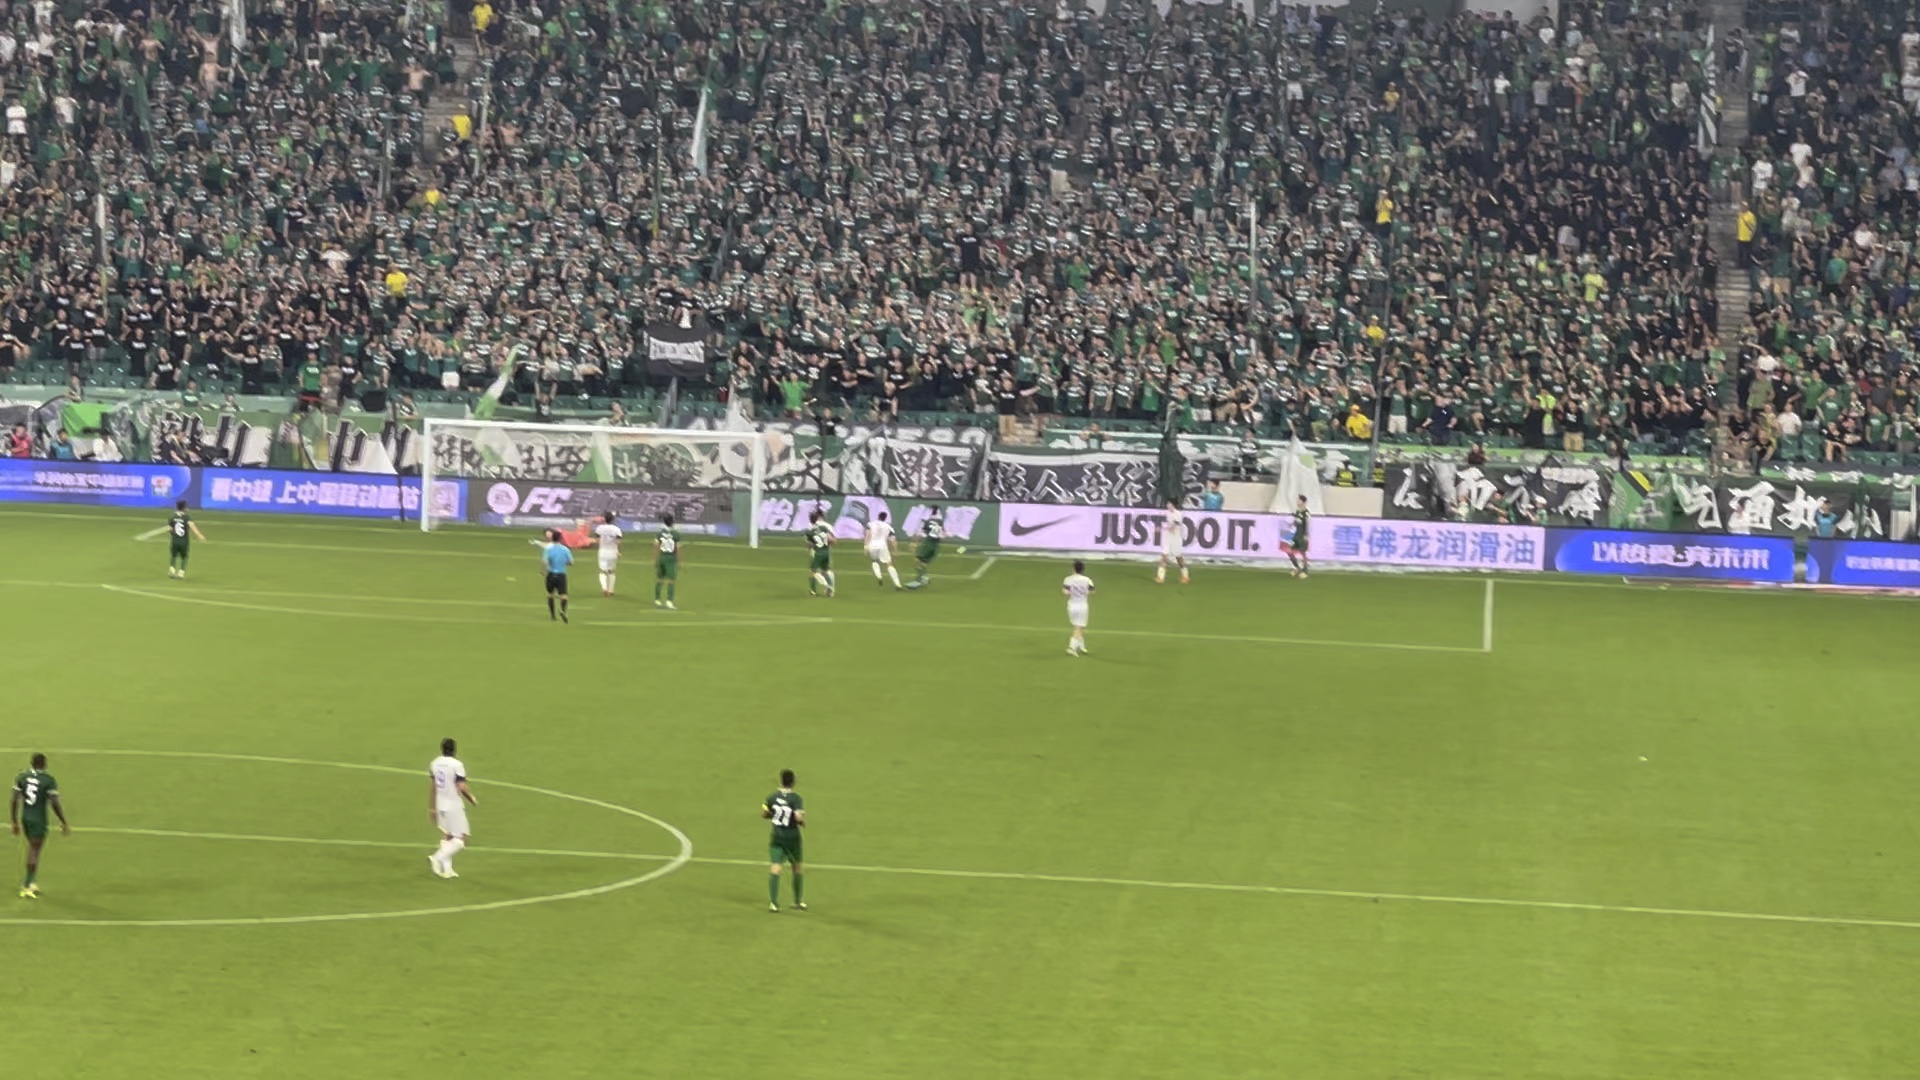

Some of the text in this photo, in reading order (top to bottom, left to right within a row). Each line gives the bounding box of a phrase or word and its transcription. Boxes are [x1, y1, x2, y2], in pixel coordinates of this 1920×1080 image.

[520, 487, 573, 513] FC
[1095, 512, 1168, 547] JUST
[1227, 518, 1260, 551] IT.
[25, 783, 38, 806] 5
